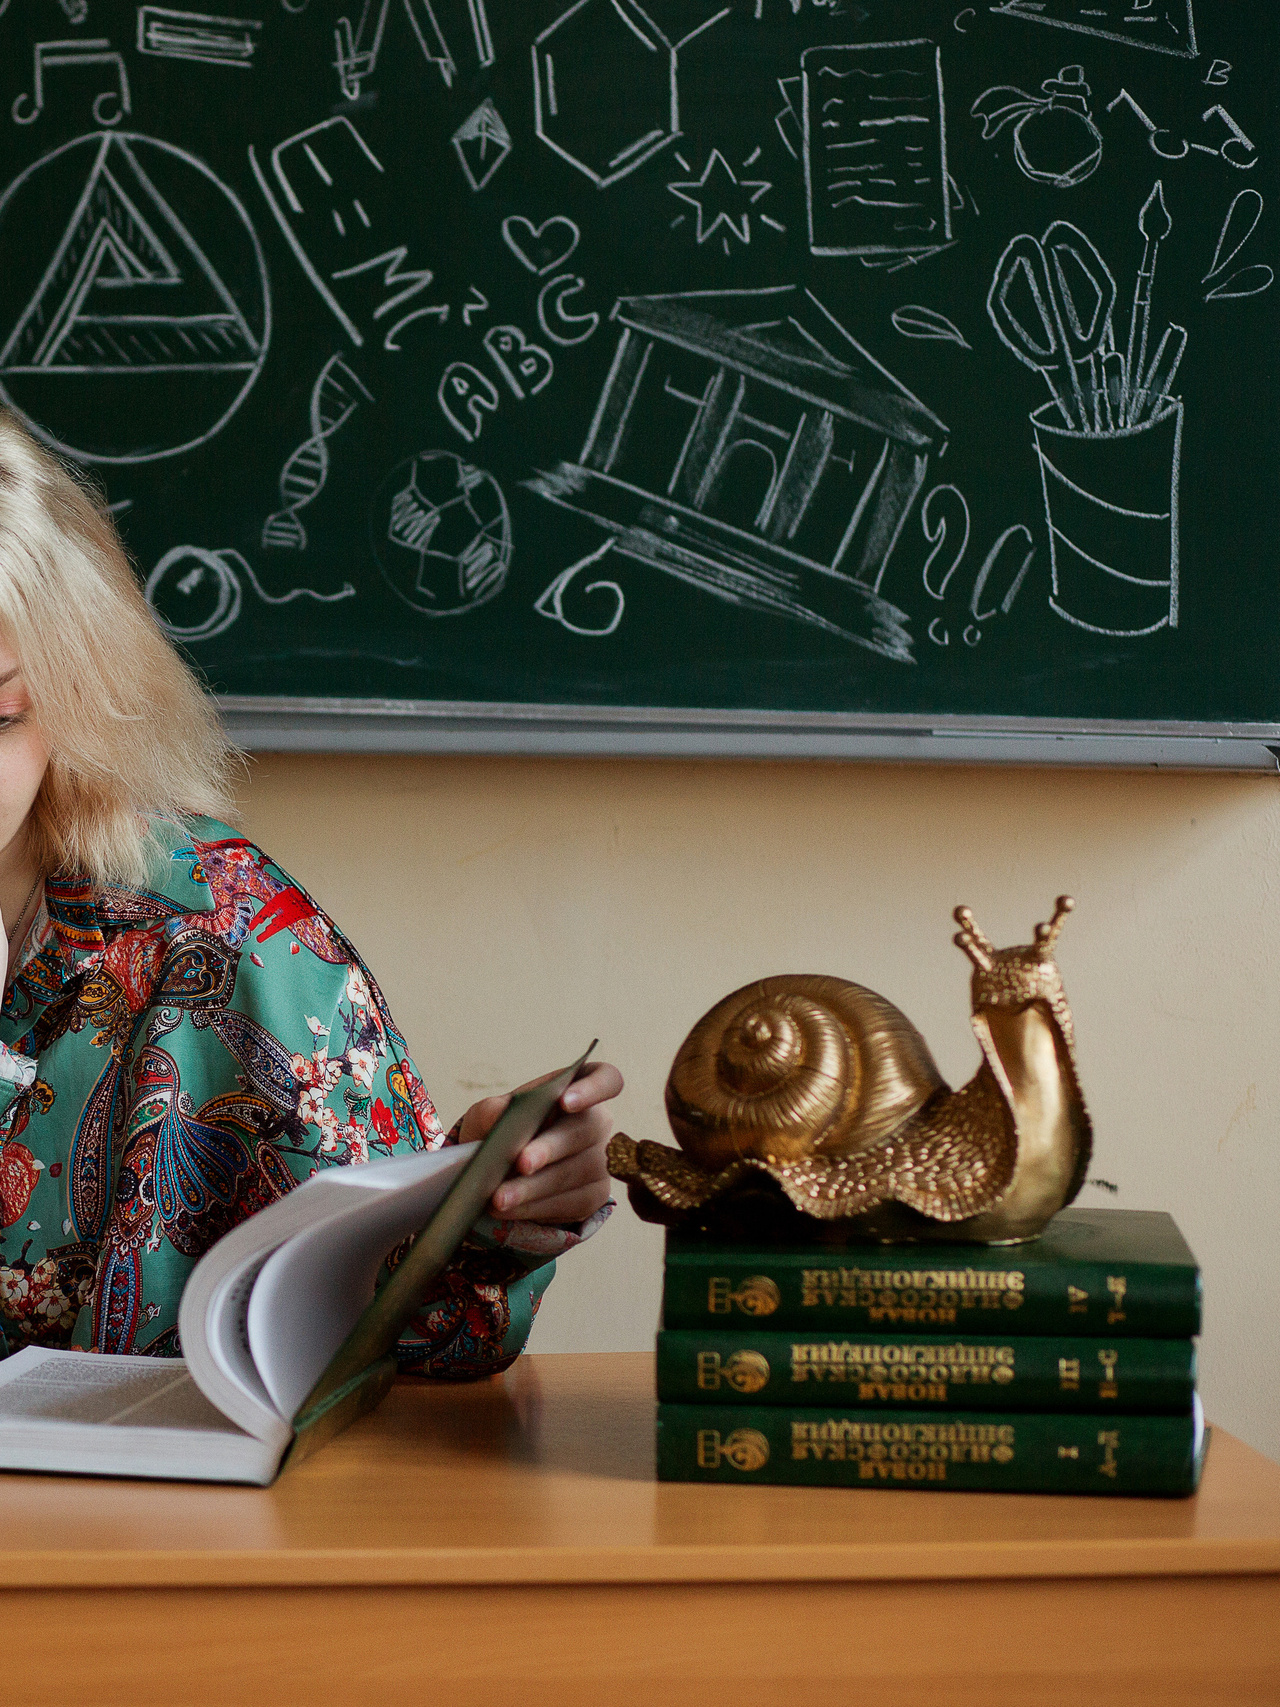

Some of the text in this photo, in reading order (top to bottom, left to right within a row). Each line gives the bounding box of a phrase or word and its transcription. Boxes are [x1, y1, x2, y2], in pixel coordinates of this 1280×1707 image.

[437, 273, 599, 443] ABC
[801, 1266, 1025, 1291] ЭНЦИКЛОПЕДИЯ
[802, 1288, 1024, 1310] ФИЛОСОФСКАЯ
[869, 1306, 957, 1324] НОВАЯ
[790, 1340, 1015, 1365] ЭНЦИКЛОПЕДИЯ
[790, 1363, 1015, 1385] ФИЛОСОФСКАЯ
[858, 1383, 948, 1401] НОВАЯ
[790, 1418, 1015, 1444] ЭНЦИКЛОПЕДИЯ
[790, 1442, 1015, 1464] ФИЛОСОФСКАЯ
[858, 1461, 947, 1481] НОВАЯ
